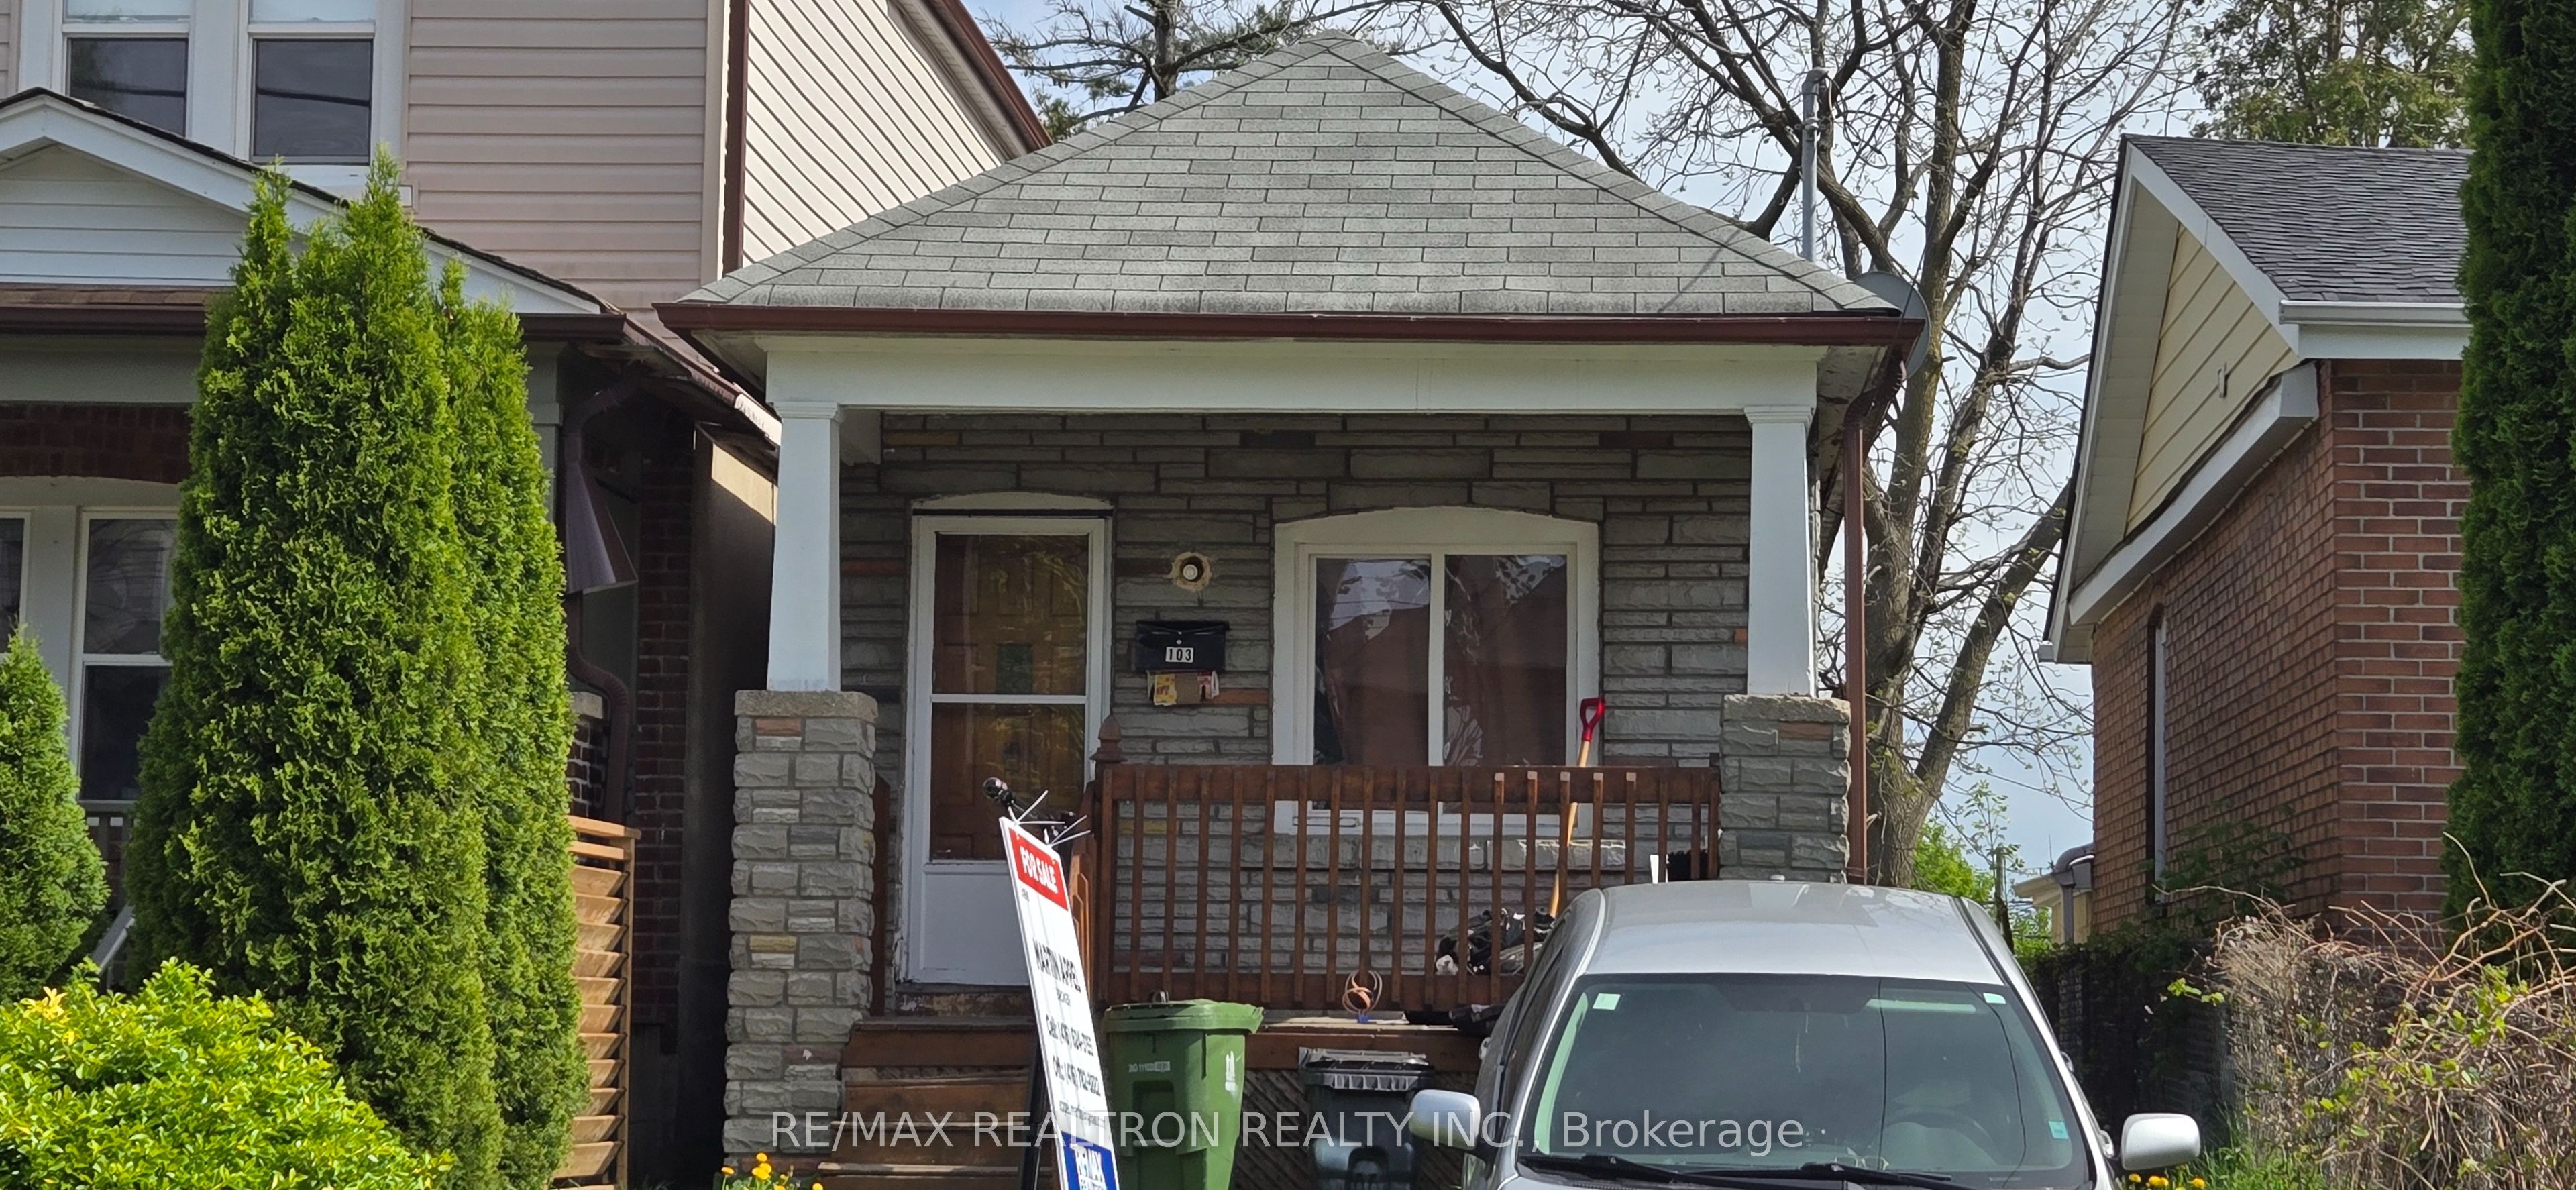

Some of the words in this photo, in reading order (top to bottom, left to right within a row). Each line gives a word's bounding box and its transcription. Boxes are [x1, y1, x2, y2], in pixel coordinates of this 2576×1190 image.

[1169, 648, 1192, 662] 103
[1019, 845, 1039, 882] FOR
[1036, 857, 1059, 894] SALE
